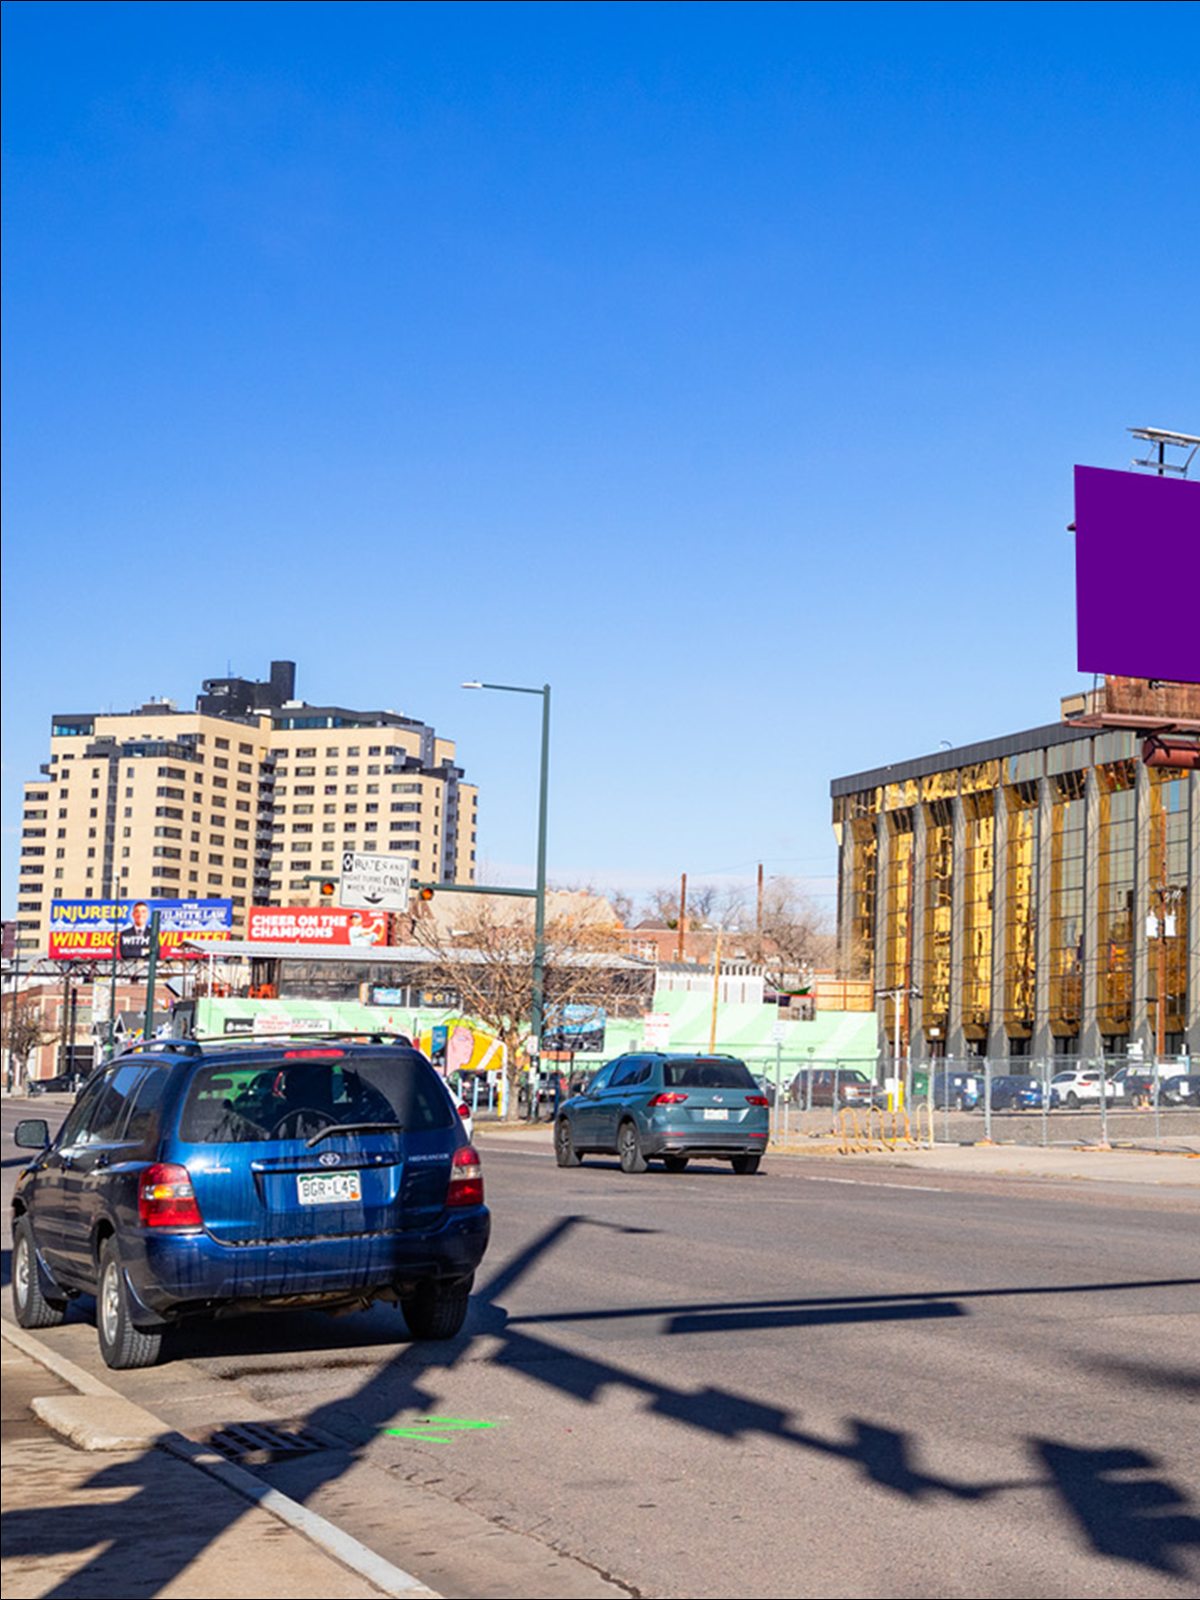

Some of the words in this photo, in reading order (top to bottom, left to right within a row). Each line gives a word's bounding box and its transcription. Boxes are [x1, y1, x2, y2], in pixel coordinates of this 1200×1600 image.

[383, 875, 406, 887] ONLY
[53, 905, 128, 922] INJURED?
[251, 915, 296, 927] CHEER
[297, 916, 318, 927] ON
[320, 916, 347, 927] THE
[250, 926, 334, 938] CHAMPIONS
[52, 932, 87, 947] WIN
[121, 936, 150, 946] WITH
